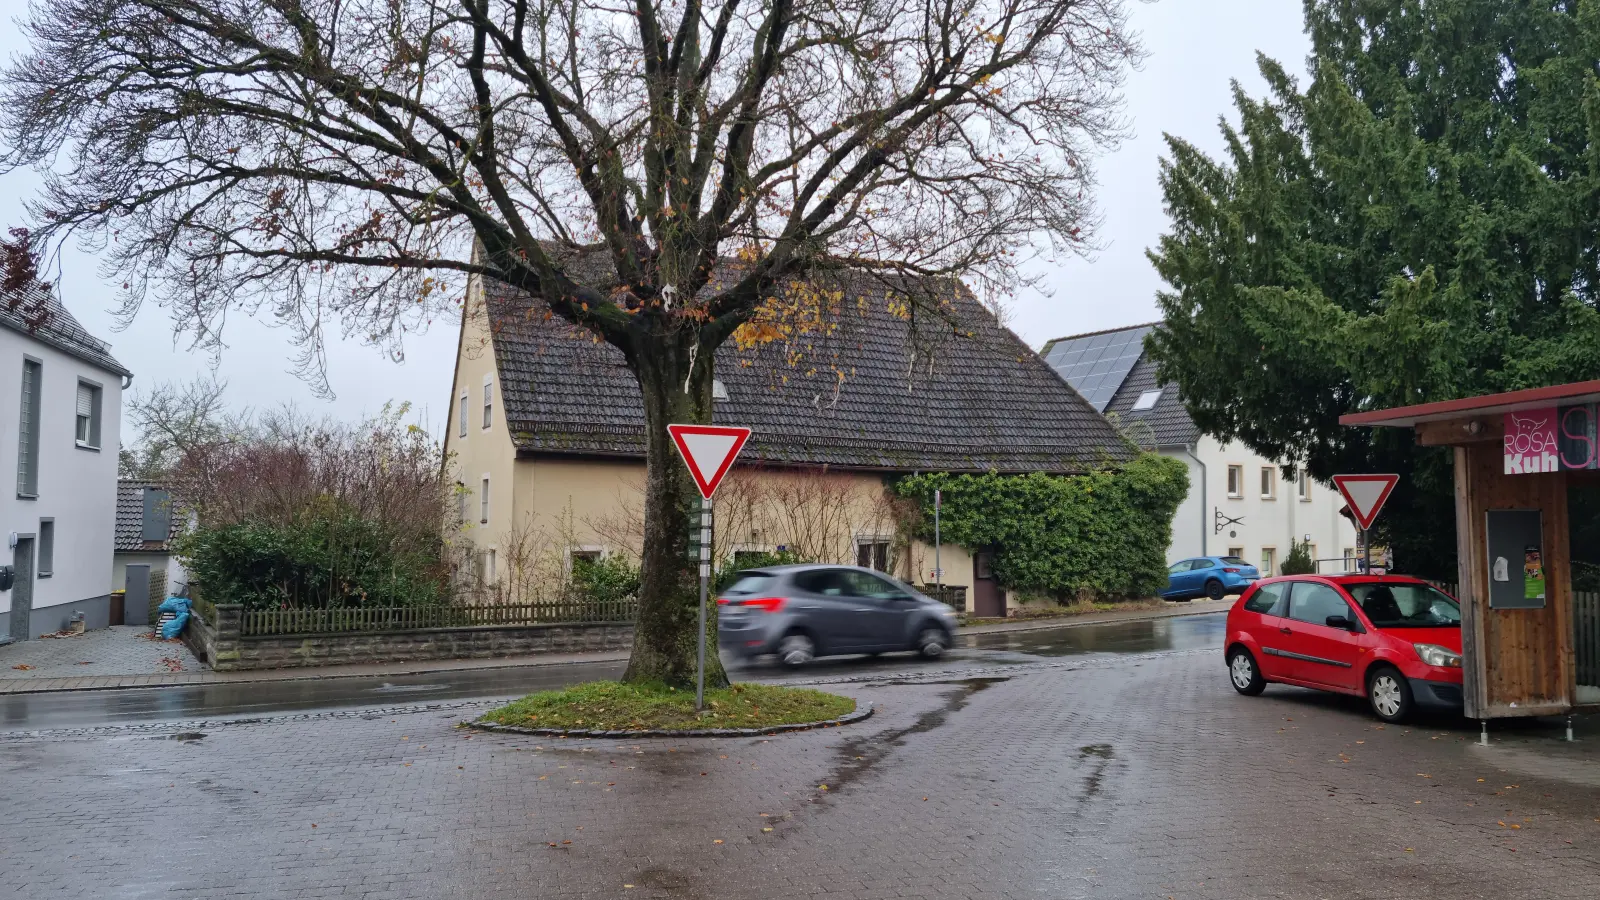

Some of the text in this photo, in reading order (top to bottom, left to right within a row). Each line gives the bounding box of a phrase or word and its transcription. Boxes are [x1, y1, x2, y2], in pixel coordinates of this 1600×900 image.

[1504, 431, 1558, 453] ROSA
[1560, 407, 1600, 469] S
[1504, 451, 1558, 474] Kuh
